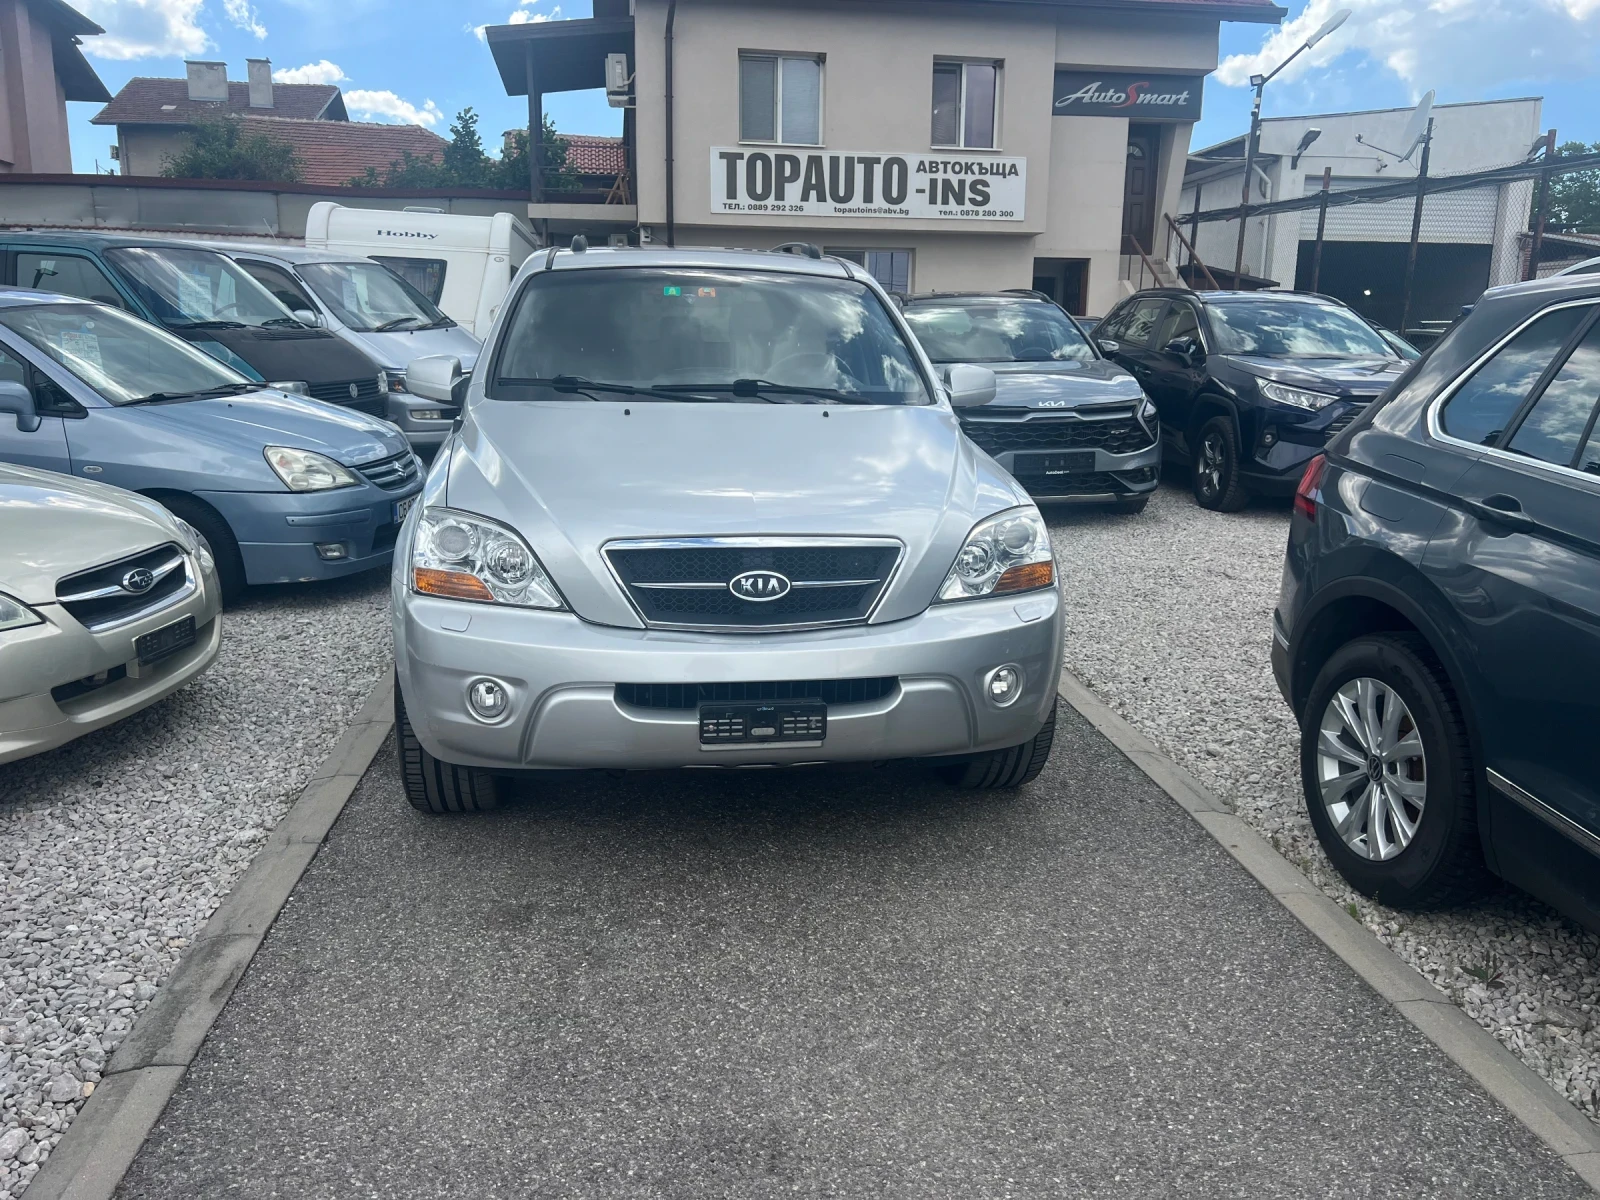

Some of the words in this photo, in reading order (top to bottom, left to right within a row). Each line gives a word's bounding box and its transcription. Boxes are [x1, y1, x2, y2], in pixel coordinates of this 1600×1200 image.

[1055, 81, 1189, 108] AutoSmart
[915, 160, 1020, 179] АВТОКЪЩА
[719, 152, 909, 205] TOPAUTO
[915, 178, 991, 207] -INS
[747, 203, 769, 211] 0889
[770, 204, 787, 212] 292
[788, 204, 804, 212] 326
[834, 206, 910, 216] topautoins@abv.bg
[960, 209, 980, 217] 0878
[998, 210, 1014, 218] 300
[377, 229, 439, 240] Hobby
[740, 577, 781, 594] KIA
